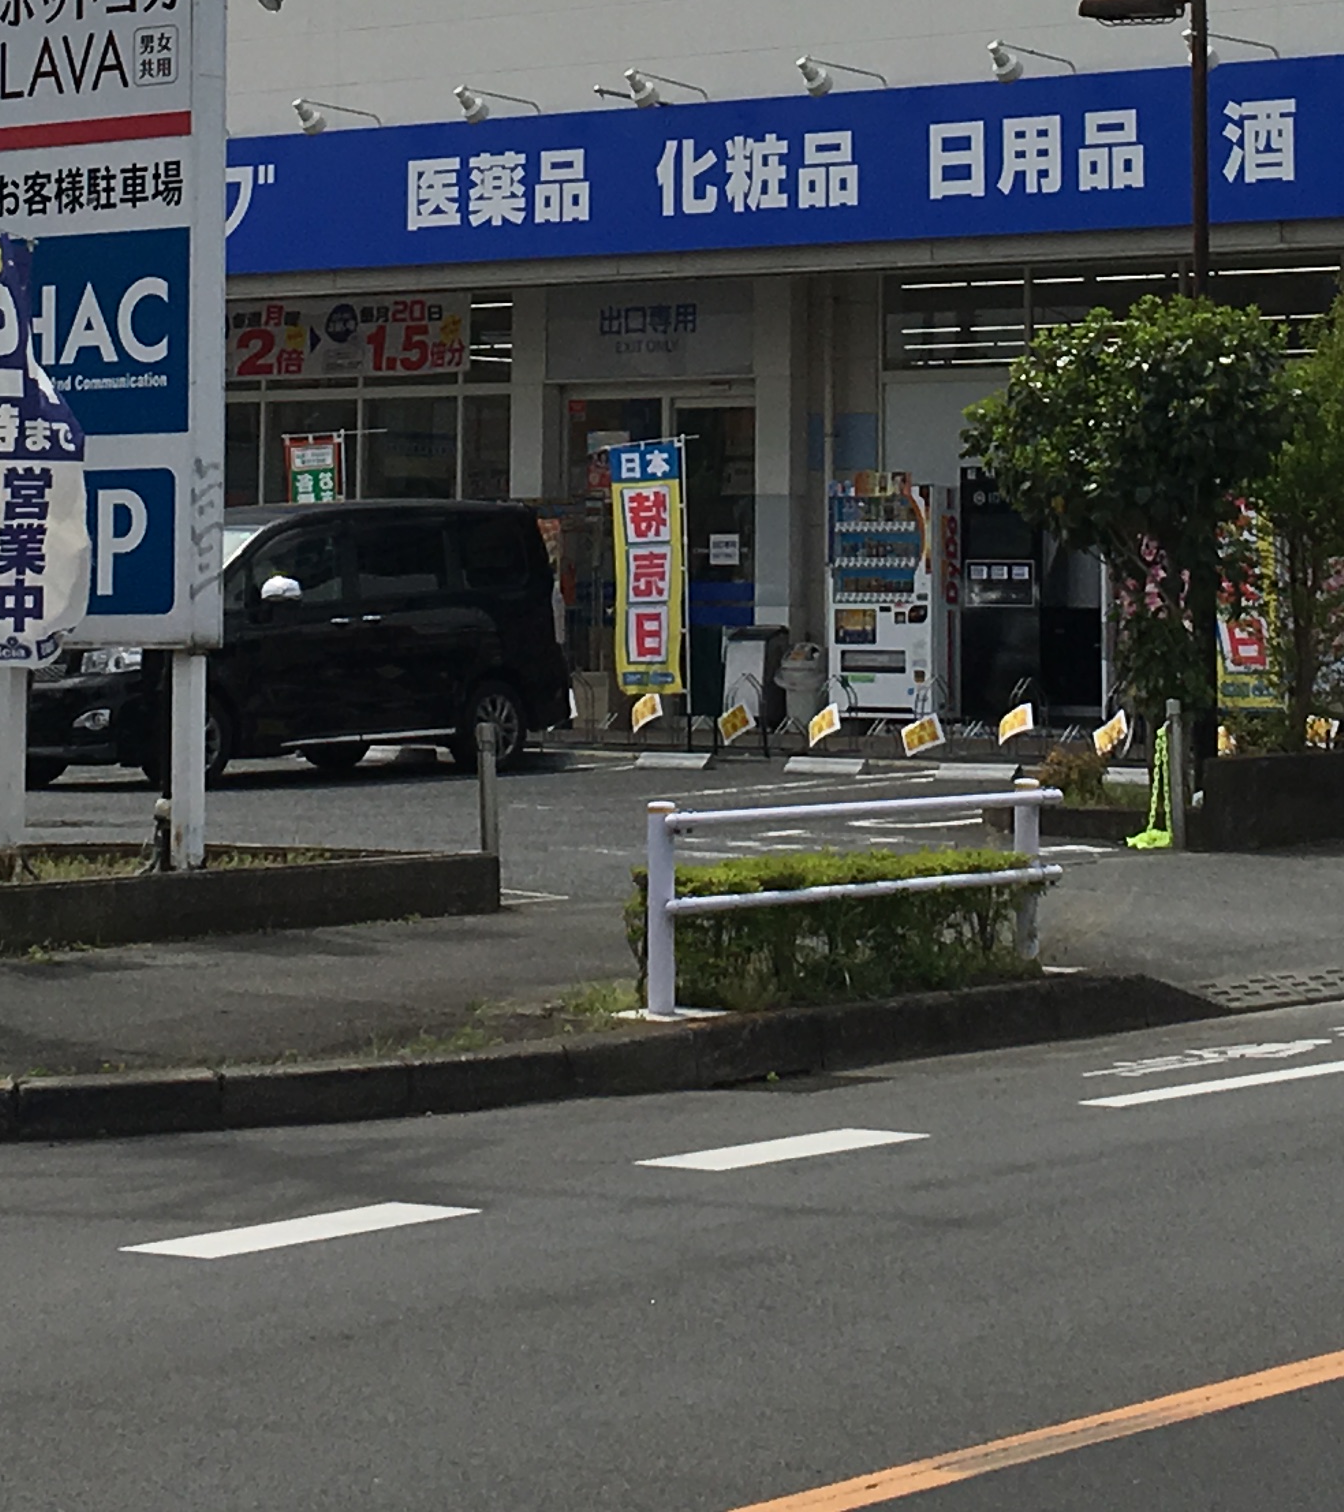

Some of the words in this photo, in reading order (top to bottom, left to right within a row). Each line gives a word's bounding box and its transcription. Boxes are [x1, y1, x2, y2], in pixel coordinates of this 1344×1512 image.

[139, 33, 173, 55] 男女
[0, 29, 129, 100] LAVA
[138, 57, 172, 80] 共用
[406, 148, 590, 231] 医薬品
[656, 130, 859, 217] 化粧品
[929, 108, 1145, 200] 日用品
[1222, 98, 1297, 184] 酒
[599, 303, 698, 335] 出口専用
[52, 374, 72, 391] nd
[74, 371, 168, 391] Communication
[96, 488, 148, 596] P
